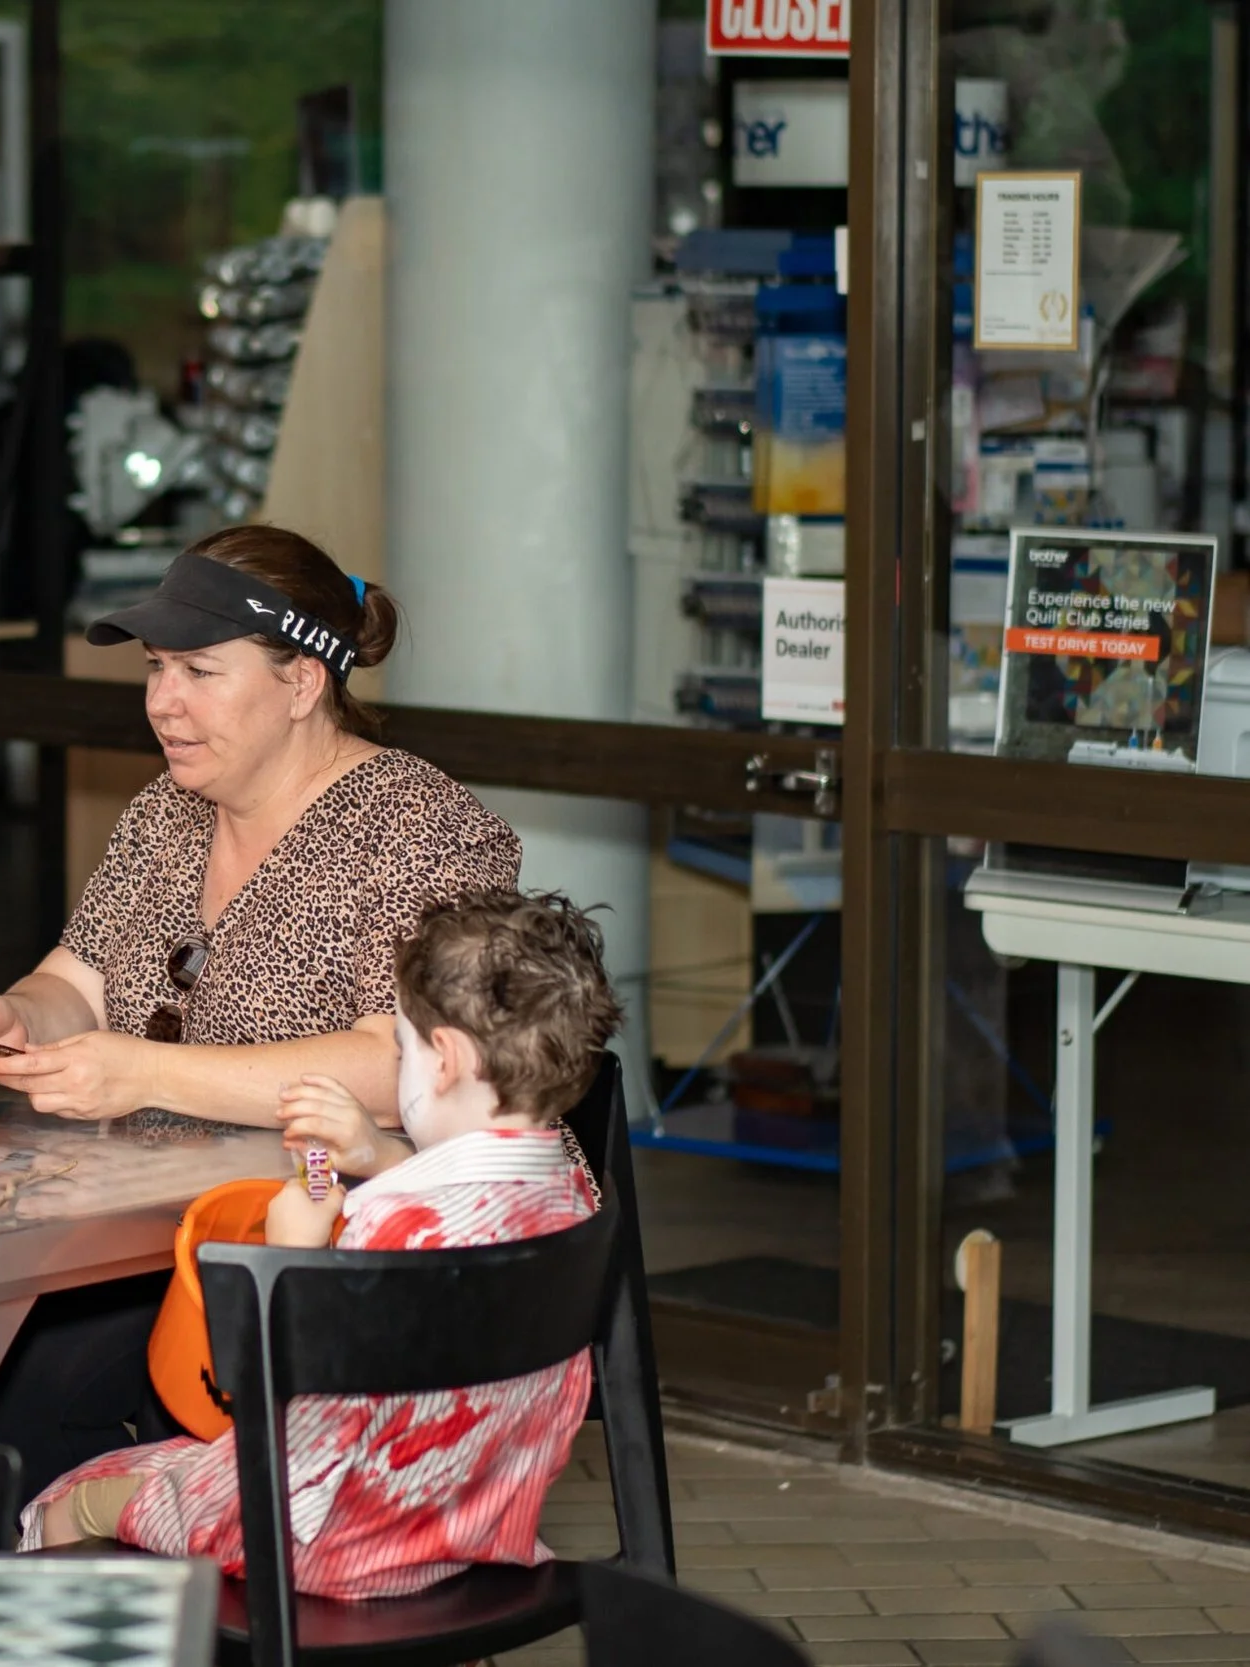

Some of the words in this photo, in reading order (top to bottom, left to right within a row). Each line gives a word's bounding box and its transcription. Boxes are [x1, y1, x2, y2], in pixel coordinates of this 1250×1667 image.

[1027, 589, 1111, 609] Experience
[1114, 594, 1140, 611] the
[1143, 599, 1176, 613] new
[1025, 608, 1062, 626] Quilt
[1066, 611, 1101, 626] Club
[1104, 614, 1150, 630] Series
[776, 638, 831, 660] Dealer
[1024, 634, 1056, 649] TEST
[1057, 637, 1098, 652] DRIVE
[1101, 641, 1146, 656] TODAY
